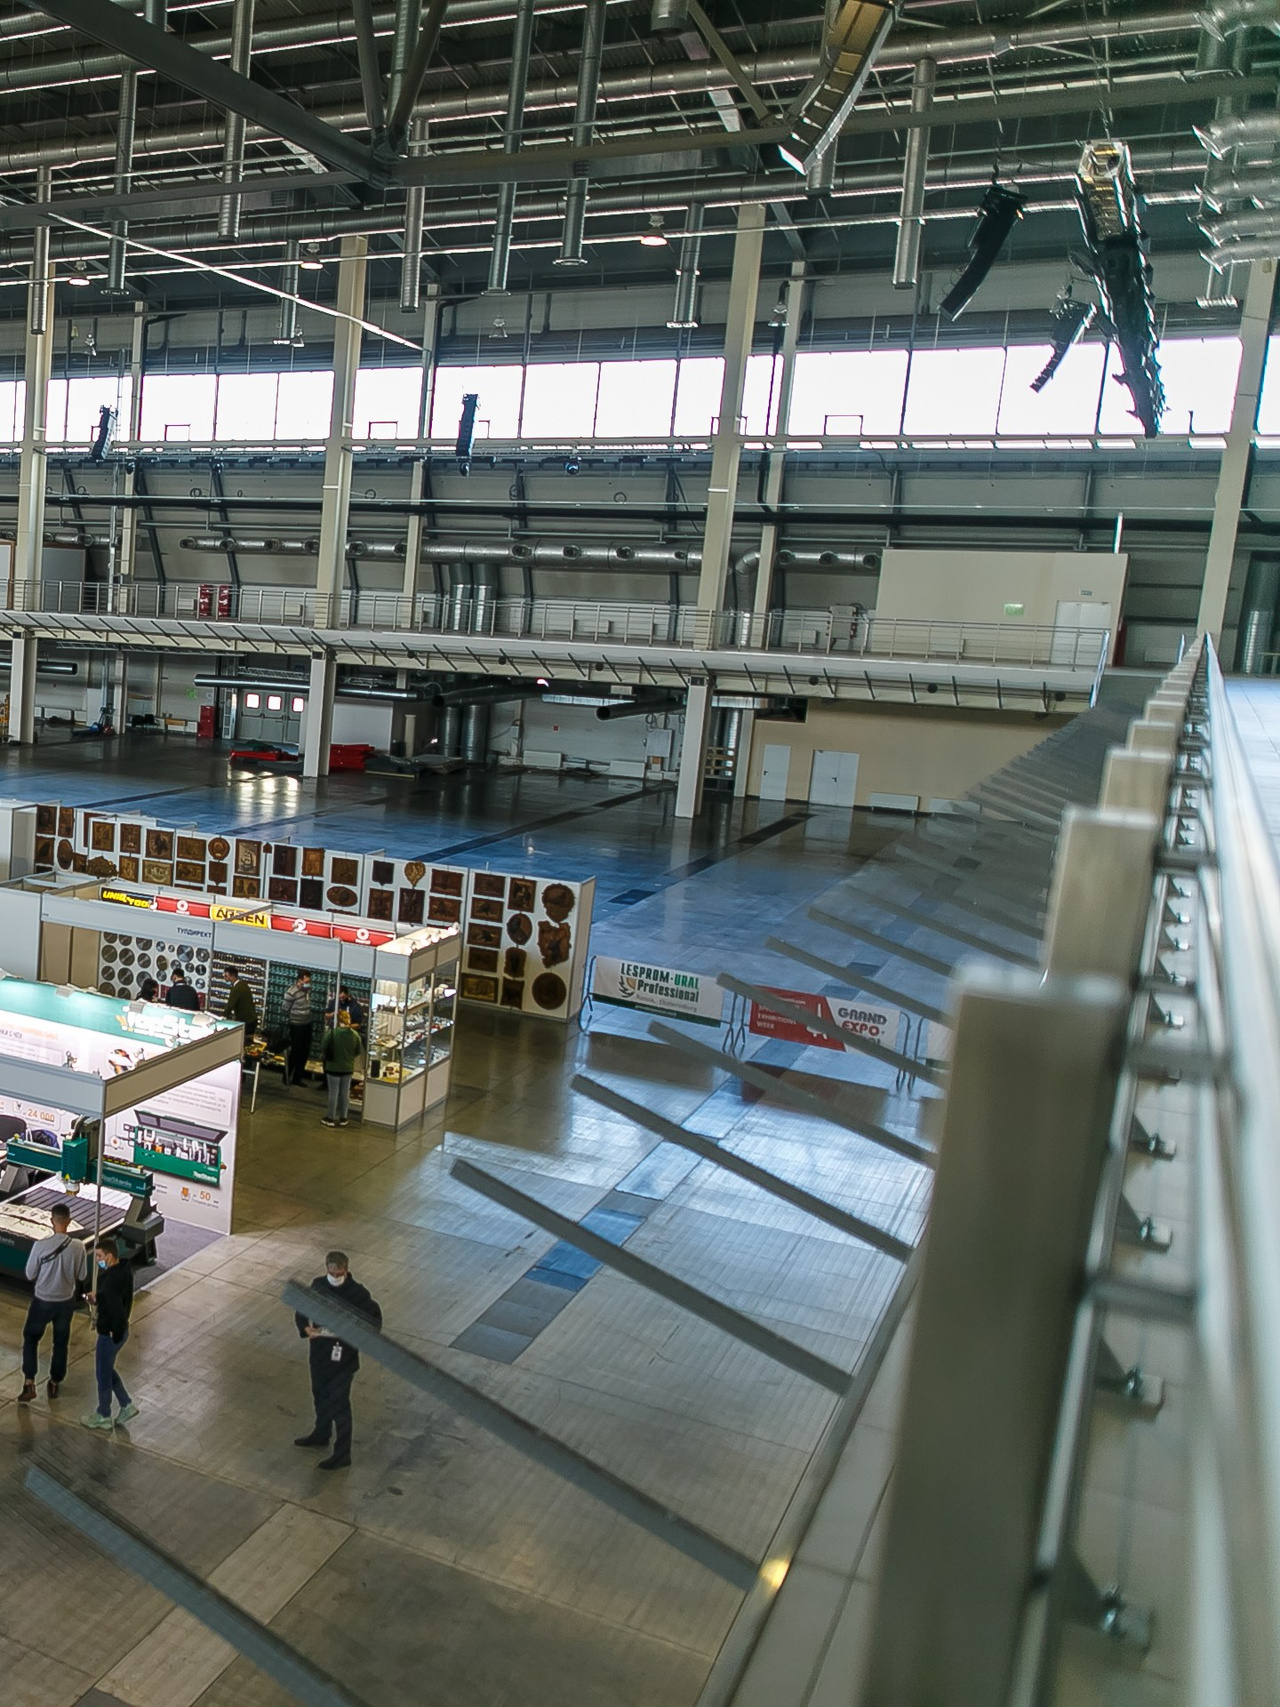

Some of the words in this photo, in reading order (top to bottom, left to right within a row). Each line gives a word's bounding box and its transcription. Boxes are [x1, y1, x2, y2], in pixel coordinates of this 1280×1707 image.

[176, 927, 212, 939] ТУЛДИРЕКТ
[637, 979, 700, 1003] Professional
[837, 1007, 888, 1026] GRAND
[756, 1020, 776, 1031] WEEK
